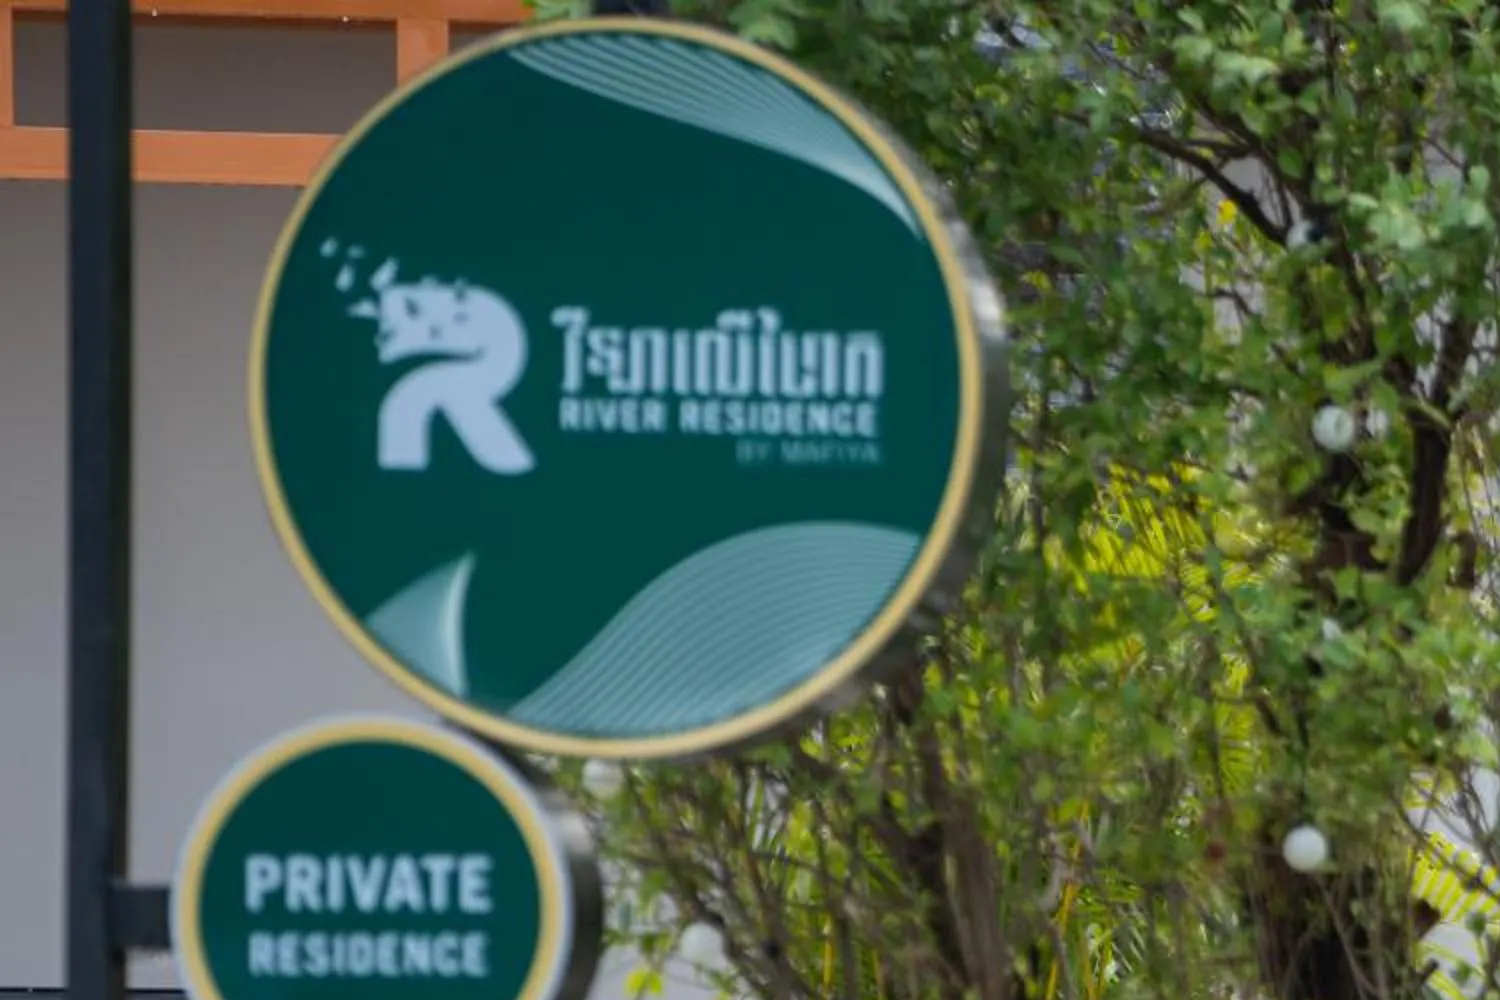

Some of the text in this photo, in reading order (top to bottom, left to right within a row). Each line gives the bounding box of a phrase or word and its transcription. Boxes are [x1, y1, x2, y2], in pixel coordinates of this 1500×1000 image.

[559, 398, 877, 437] RIVER RESIDENCE
[245, 853, 493, 913] PRIVATE
[248, 931, 488, 977] RESIDENCE
